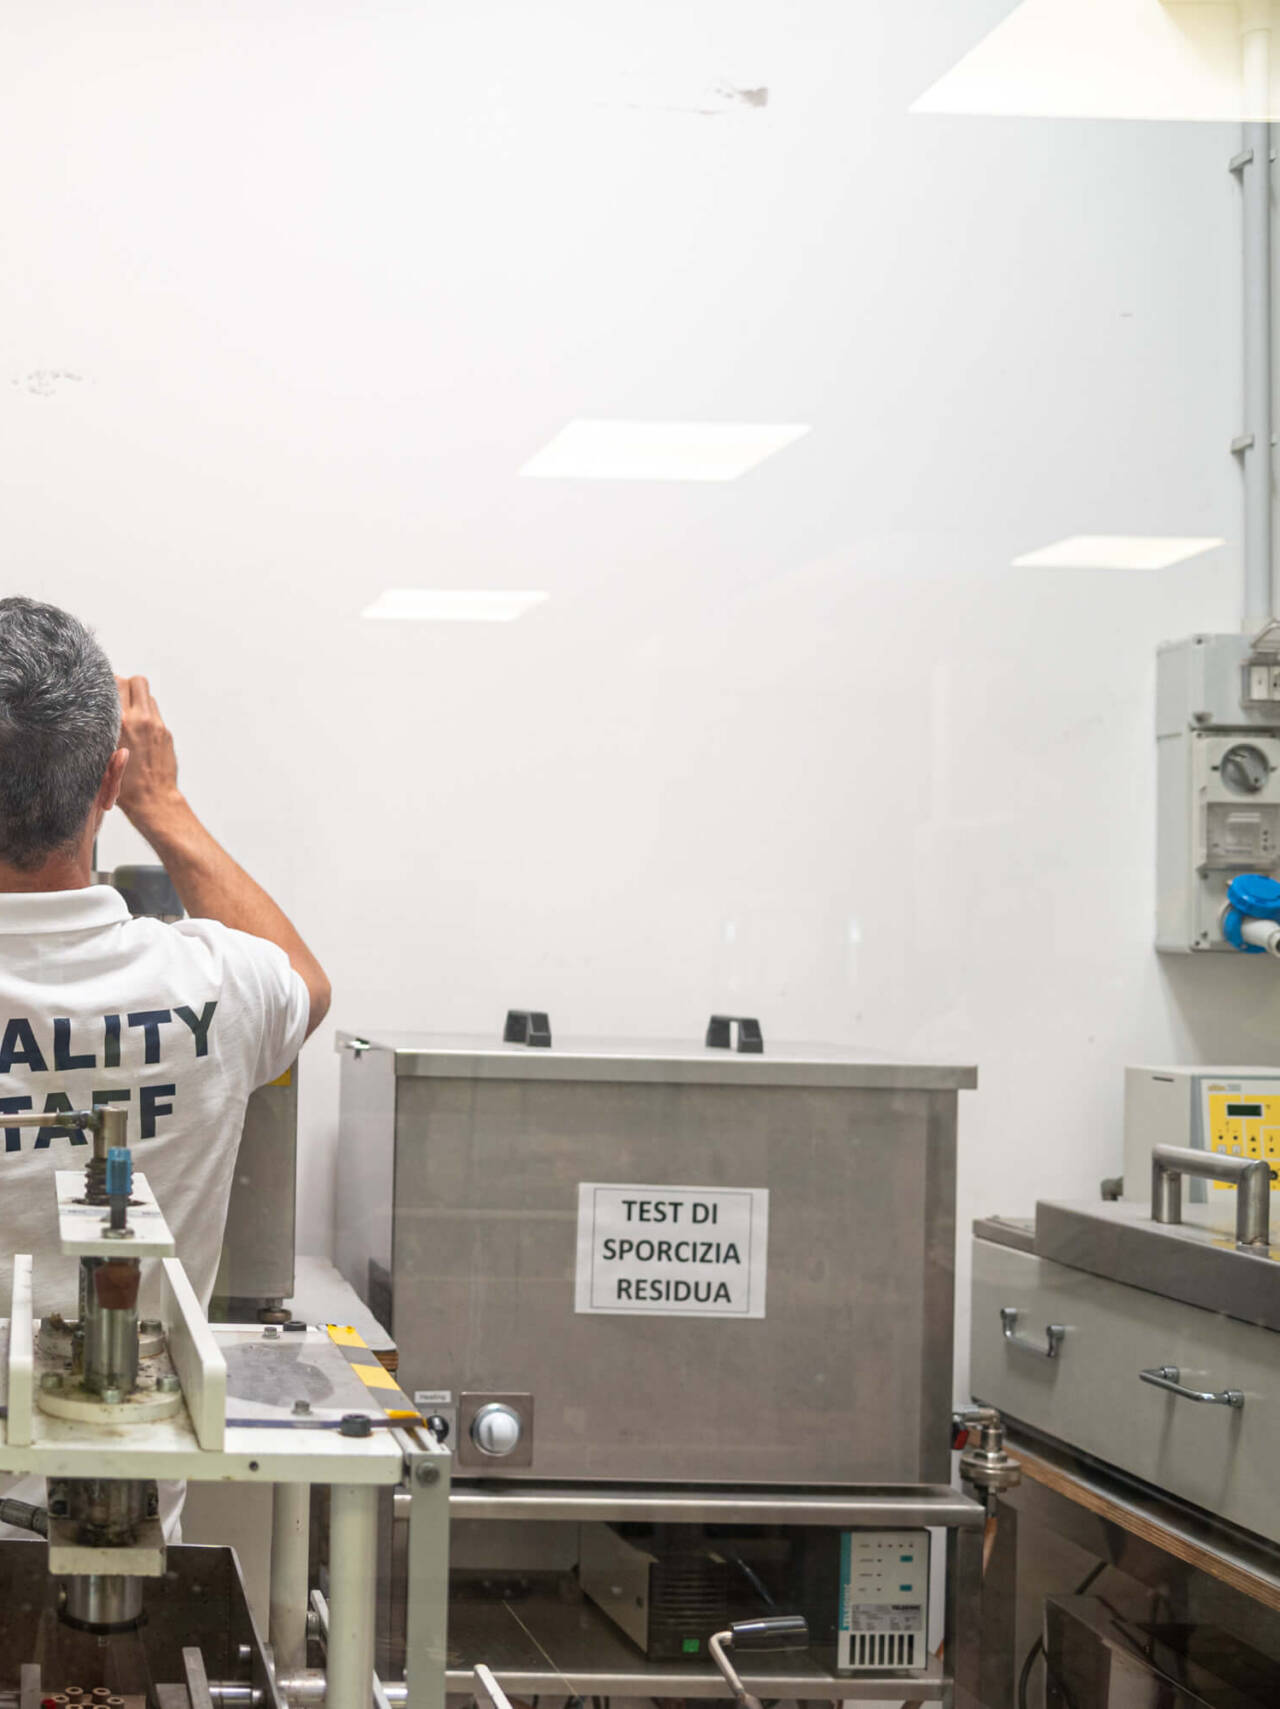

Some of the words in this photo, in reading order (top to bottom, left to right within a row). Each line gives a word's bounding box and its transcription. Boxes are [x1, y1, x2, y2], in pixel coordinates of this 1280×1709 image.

[622, 1199, 684, 1224] TEST
[692, 1202, 718, 1225] DI
[602, 1238, 741, 1265] SPORCIZIA
[616, 1278, 732, 1304] RESIDUA
